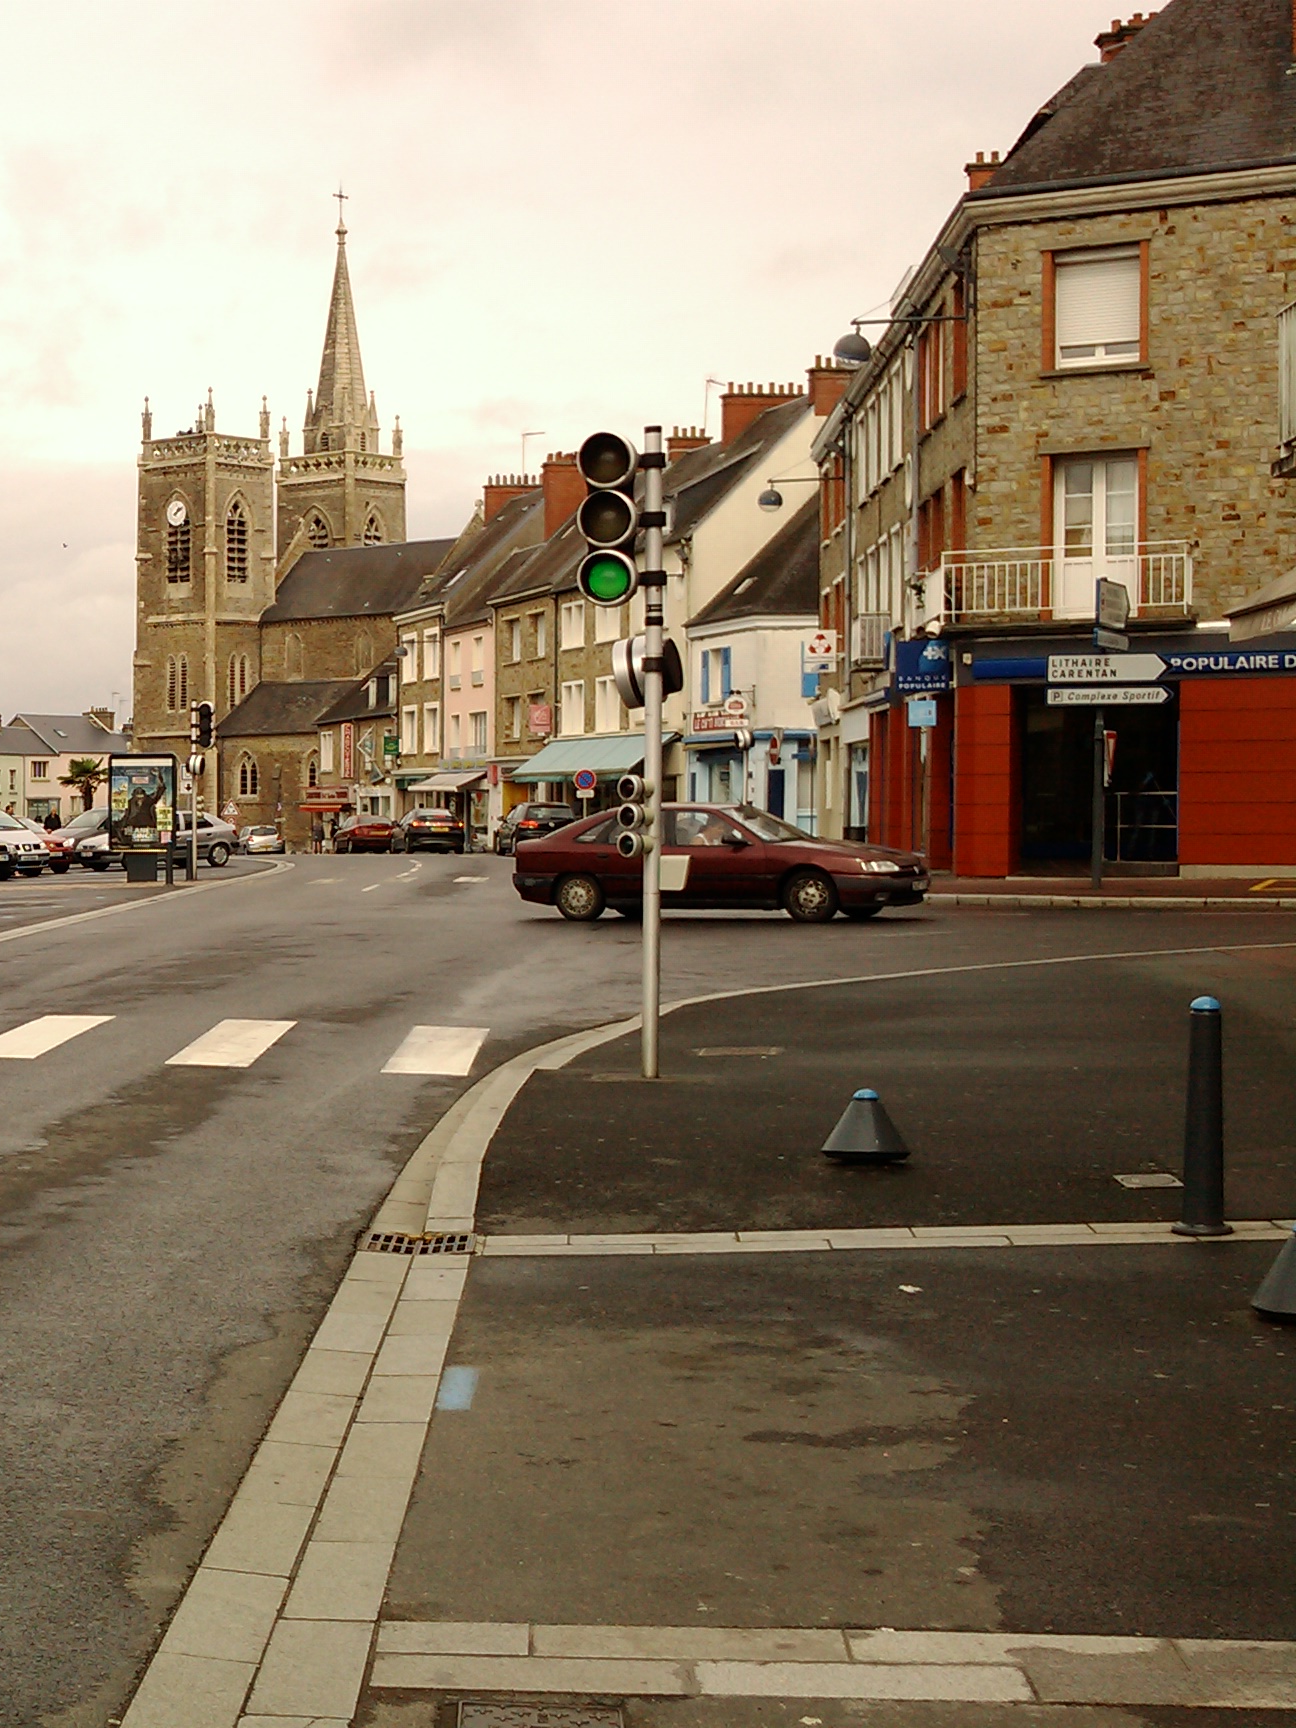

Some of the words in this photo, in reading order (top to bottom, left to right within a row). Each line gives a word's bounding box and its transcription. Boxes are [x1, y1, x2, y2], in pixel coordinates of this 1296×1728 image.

[1052, 658, 1110, 667] LITHAIRE
[1170, 654, 1280, 671] POPULAIRE
[1052, 669, 1117, 678] CARENTAN
[1067, 690, 1118, 702] Complexe
[1123, 689, 1160, 701] Sportif
